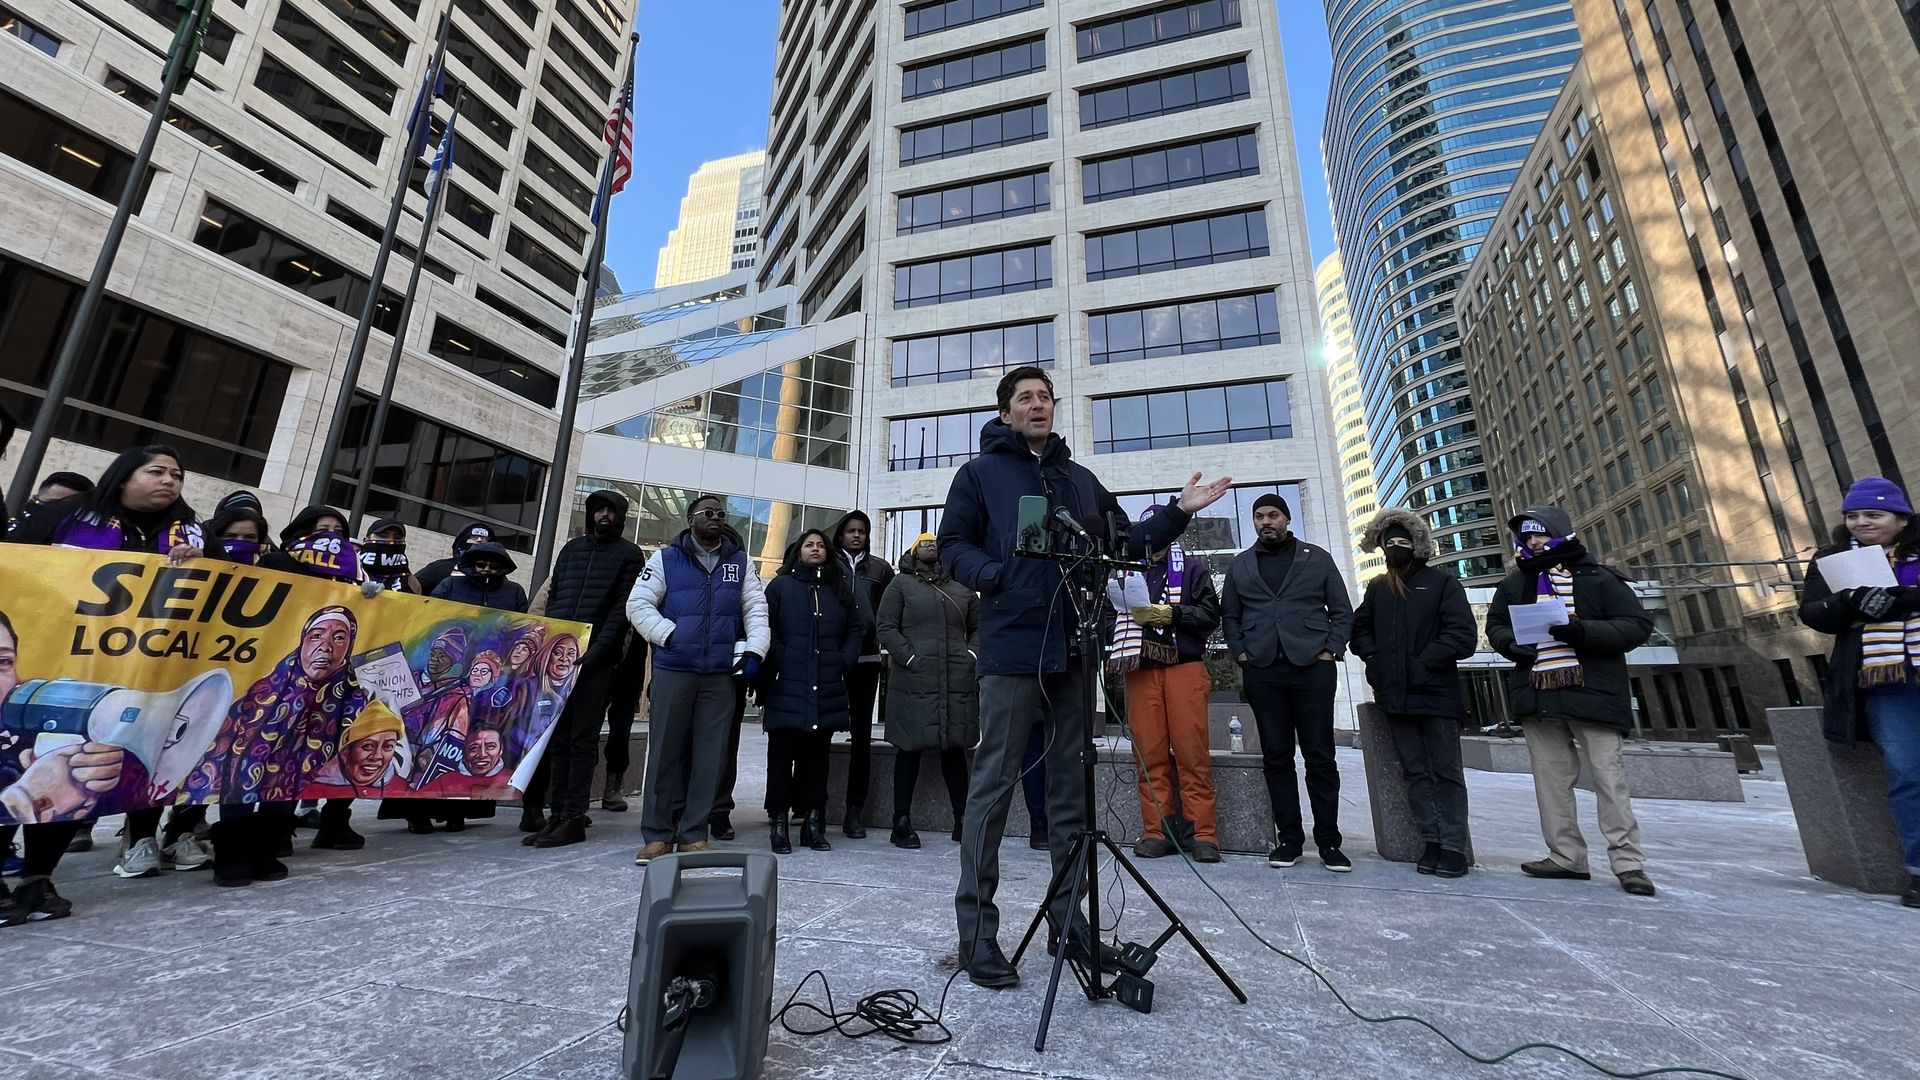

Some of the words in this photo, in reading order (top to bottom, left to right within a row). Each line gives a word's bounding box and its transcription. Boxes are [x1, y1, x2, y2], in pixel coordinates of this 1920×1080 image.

[312, 537, 341, 554] 26
[723, 564, 739, 582] H
[75, 562, 293, 628] SEIU
[70, 625, 200, 659] LOCAL
[208, 634, 259, 664] 26
